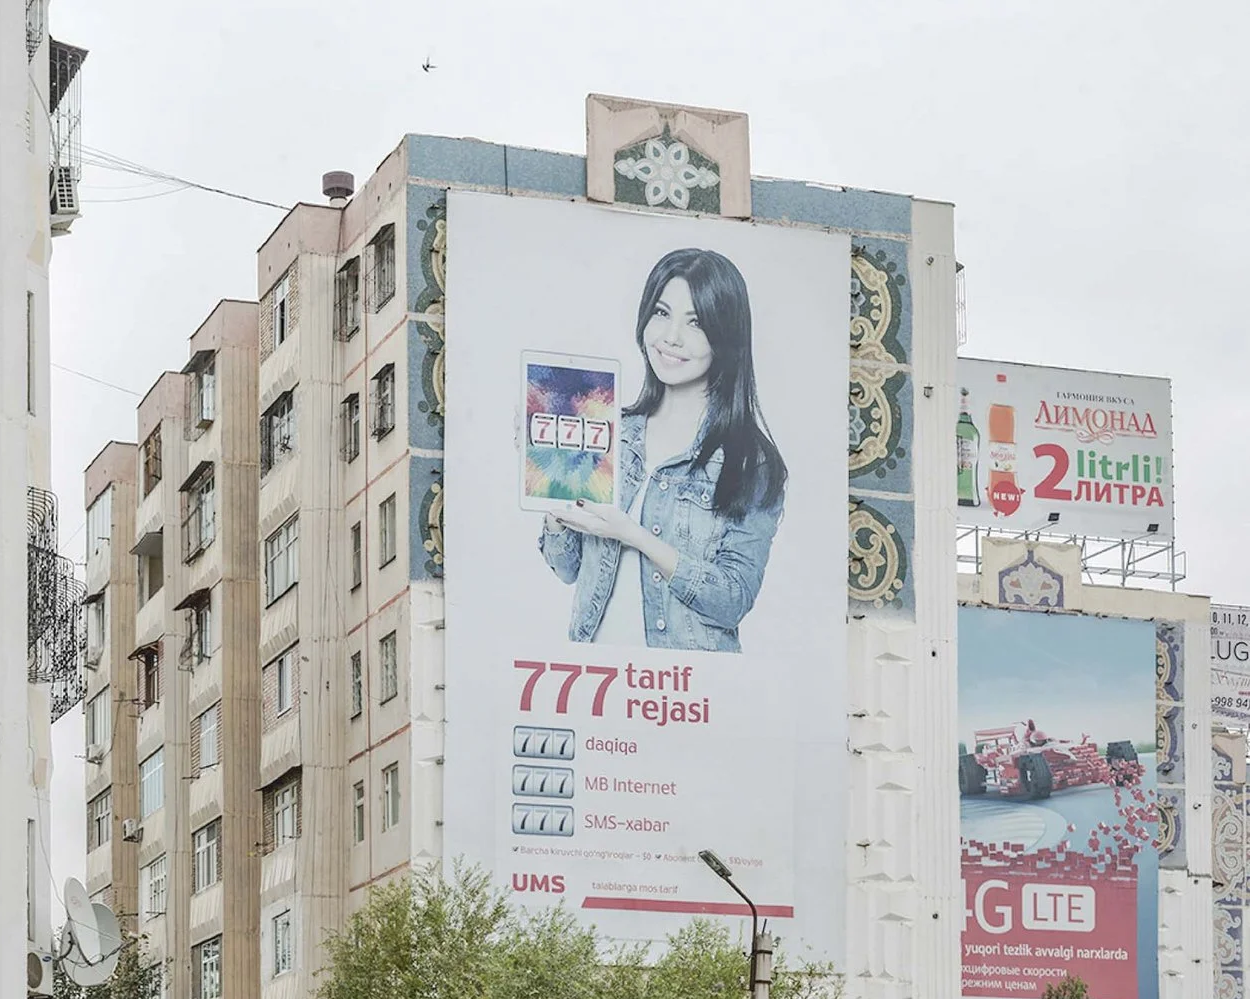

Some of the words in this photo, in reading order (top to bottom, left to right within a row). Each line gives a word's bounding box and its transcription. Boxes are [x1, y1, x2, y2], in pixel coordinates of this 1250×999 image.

[1056, 391, 1104, 402] ГАРМОНИЯ
[1106, 396, 1135, 405] ВКУСА
[1034, 400, 1157, 435] ЛИМОНАД
[1033, 443, 1072, 501] 2
[1077, 449, 1163, 484] litrli!
[993, 491, 1020, 502] NEW!
[1074, 480, 1164, 507] ЛИТРА
[1211, 640, 1249, 661] UG
[514, 660, 618, 717] 777
[625, 662, 693, 692] tarif
[626, 696, 709, 726] rejasi
[585, 736, 638, 755] daqiqa
[584, 776, 608, 792] MB
[613, 778, 677, 796] Internet
[520, 846, 549, 856] Barcha
[512, 873, 565, 894] UMS
[592, 881, 637, 893] talablarga
[639, 884, 658, 893] mos
[659, 883, 679, 894] tarif
[1033, 892, 1084, 923] LTE
[965, 942, 1001, 957] yuqori
[1003, 943, 1033, 957] tezlik
[1035, 945, 1074, 961] avvalgi
[1076, 947, 1128, 960] narxlarda
[1022, 967, 1067, 978] скорости
[1005, 980, 1037, 991] ценам
